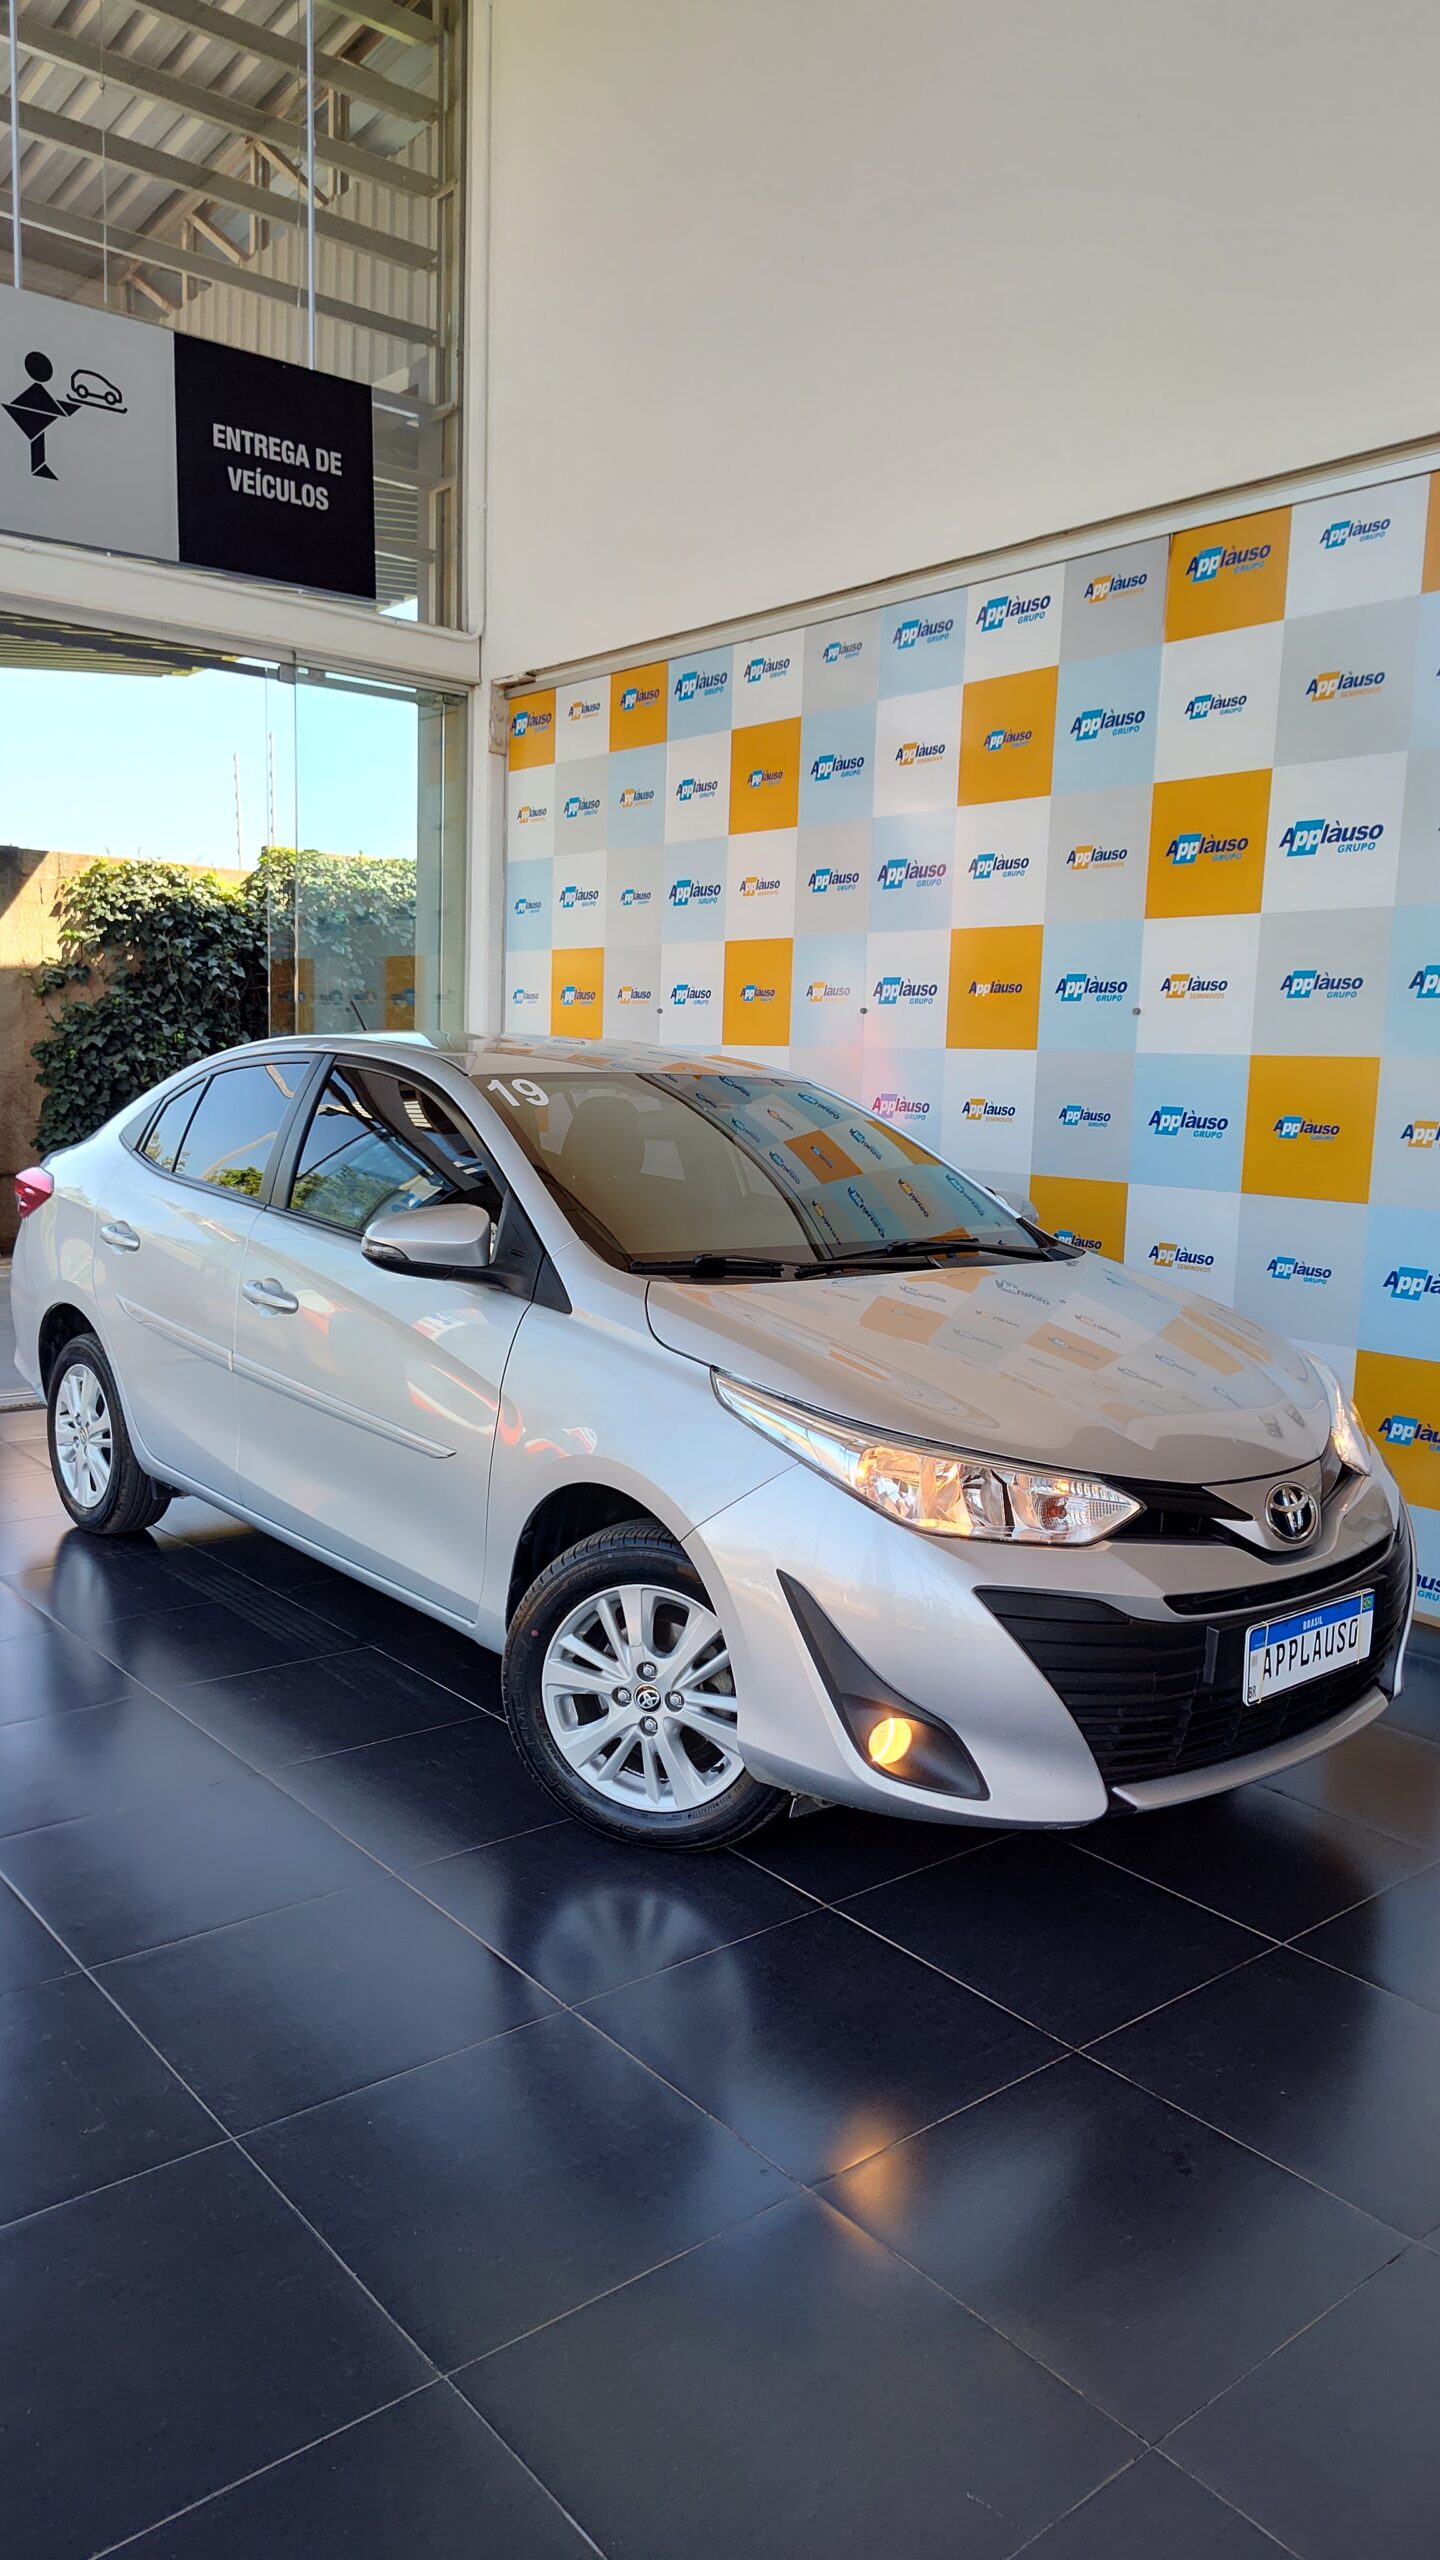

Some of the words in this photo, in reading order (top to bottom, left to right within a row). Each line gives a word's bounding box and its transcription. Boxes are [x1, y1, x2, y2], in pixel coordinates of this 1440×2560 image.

[213, 423, 310, 469] ENTREGA
[315, 448, 342, 476] DE
[227, 466, 329, 511] VEÍCULOS
[1319, 519, 1391, 550] Applàuso
[1359, 532, 1386, 542] GRUPO
[1186, 544, 1271, 583] Applàuso
[1084, 572, 1147, 604] Applàuso
[976, 595, 1051, 632] Applàuso
[1018, 611, 1045, 624] GRUPO
[893, 618, 953, 650] Applàuso
[674, 671, 727, 701] Applàuso
[1306, 671, 1385, 702] Applàuso
[1185, 694, 1247, 720] Applàuso
[1070, 708, 1145, 742] Applàuso
[1112, 725, 1140, 736] GRUPO
[811, 754, 864, 781] Applàuso
[1165, 833, 1248, 865] Applàuso
[1279, 818, 1383, 858] Applàuso
[1337, 842, 1375, 854] GRUPO
[969, 853, 1029, 880] Applàuso
[1066, 844, 1127, 870] Applàuso
[1212, 853, 1242, 862] GRUPO
[877, 858, 946, 889] Applàuso
[916, 879, 941, 888] GRUPO
[669, 879, 721, 906] Applàuso
[873, 976, 937, 1004] Applàuso
[969, 980, 1022, 995] Applàuso
[1056, 973, 1127, 1002] Applàuso
[1096, 994, 1122, 1002] GRUPO
[1161, 973, 1228, 999] Applàuso
[1280, 970, 1363, 999] Applàuso
[909, 997, 933, 1005] GRUPO
[487, 1078, 550, 1107] 19
[962, 1098, 1015, 1120] Applàuso
[1059, 1104, 1110, 1127] Applàuso
[1149, 1106, 1228, 1136] Applàuso
[1193, 1131, 1222, 1139] GRUPO
[1273, 1115, 1339, 1139] Applàuso
[1149, 1242, 1214, 1268] Applàuso
[1267, 1256, 1332, 1279] Applàuso
[1303, 1276, 1327, 1285] GRUPO
[1302, 1616, 1324, 1631] BRASIL
[1263, 1618, 1359, 1681] APPLAUSO
